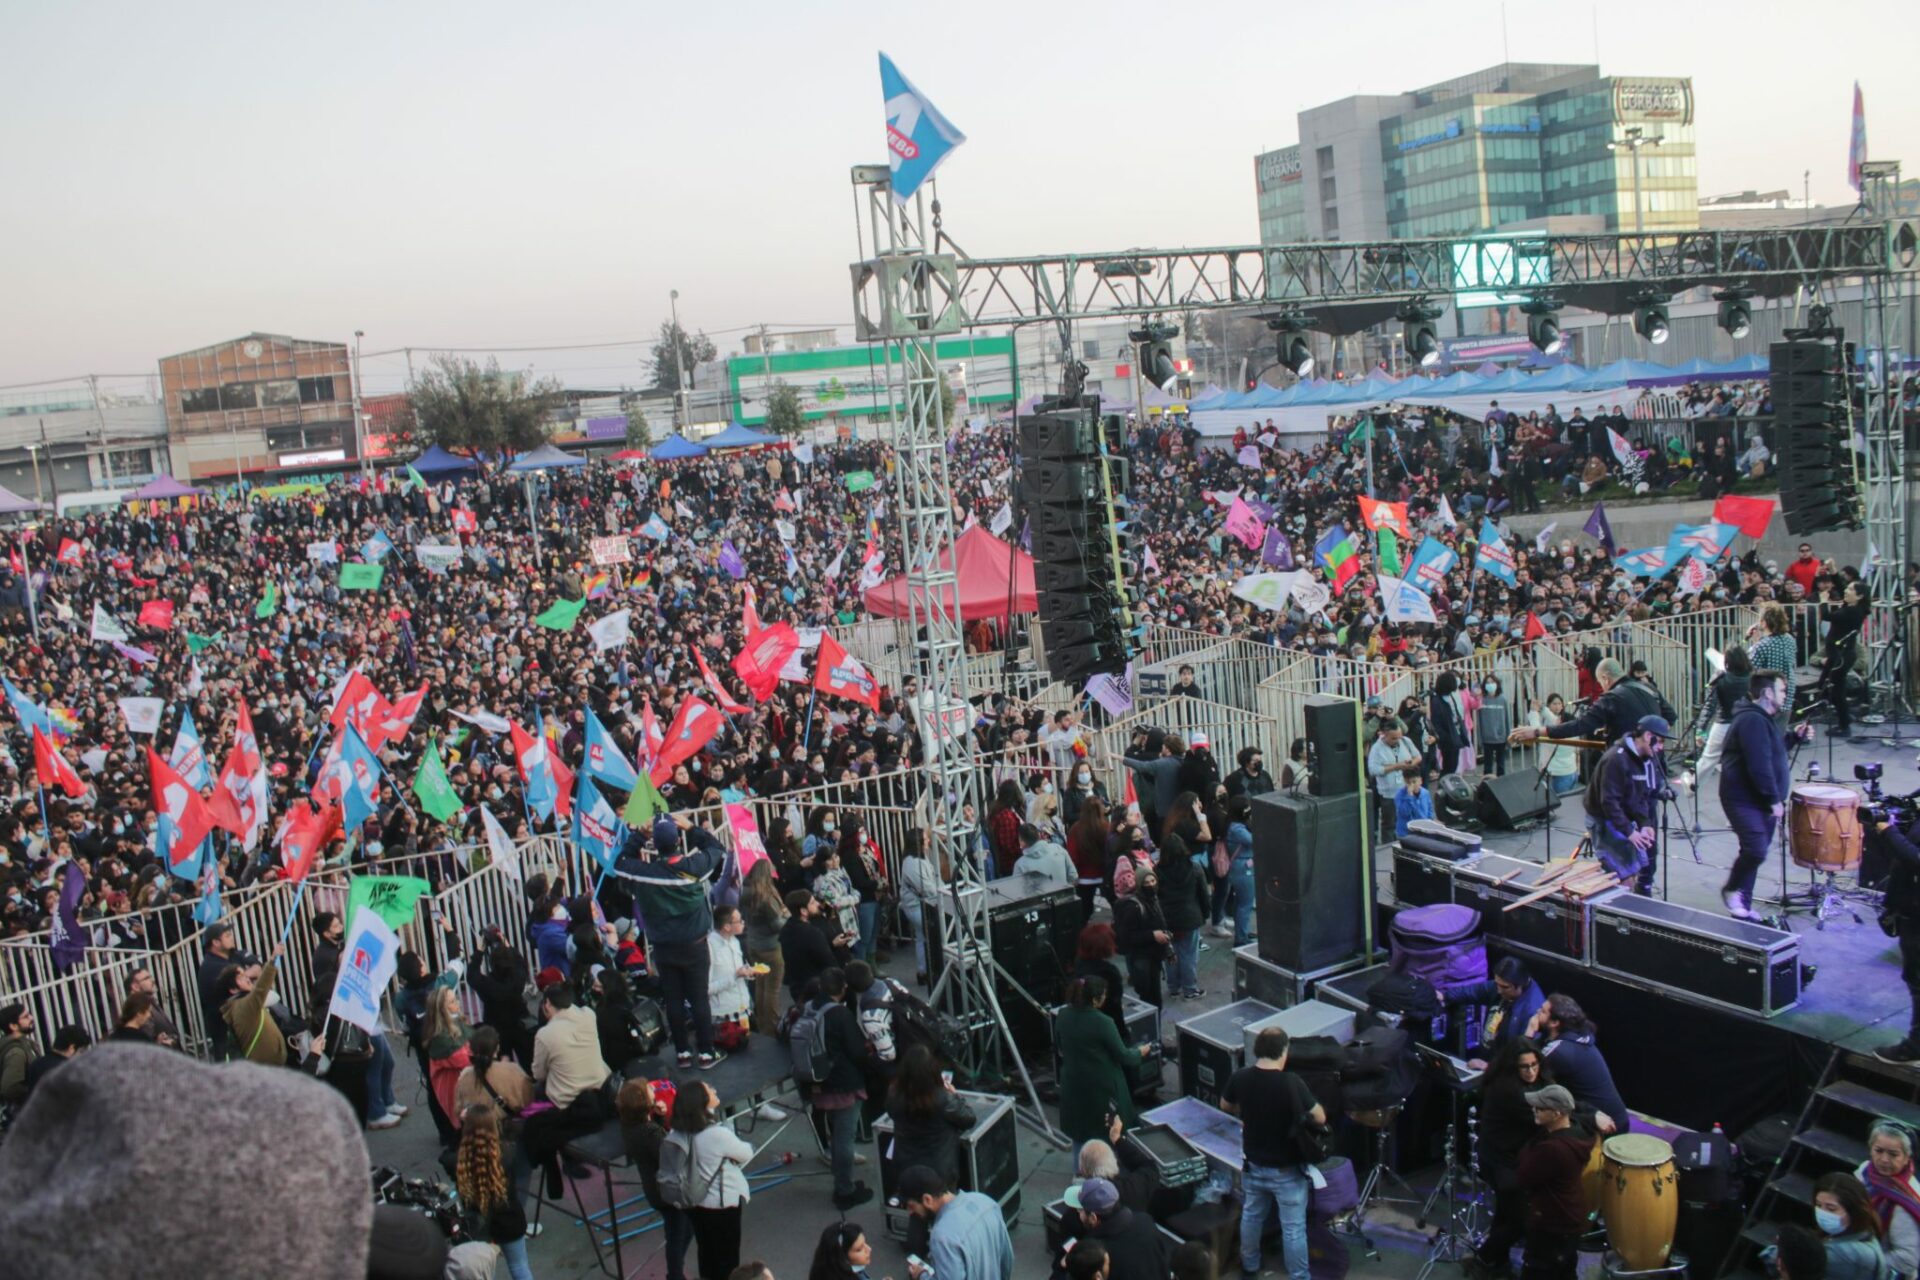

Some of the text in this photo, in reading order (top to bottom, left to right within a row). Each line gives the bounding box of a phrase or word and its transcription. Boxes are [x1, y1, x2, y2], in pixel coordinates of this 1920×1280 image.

[1621, 95, 1681, 110] URBANO
[887, 130, 916, 158] EBO
[1264, 160, 1303, 181] URBANO
[1024, 911, 1039, 923] 13
